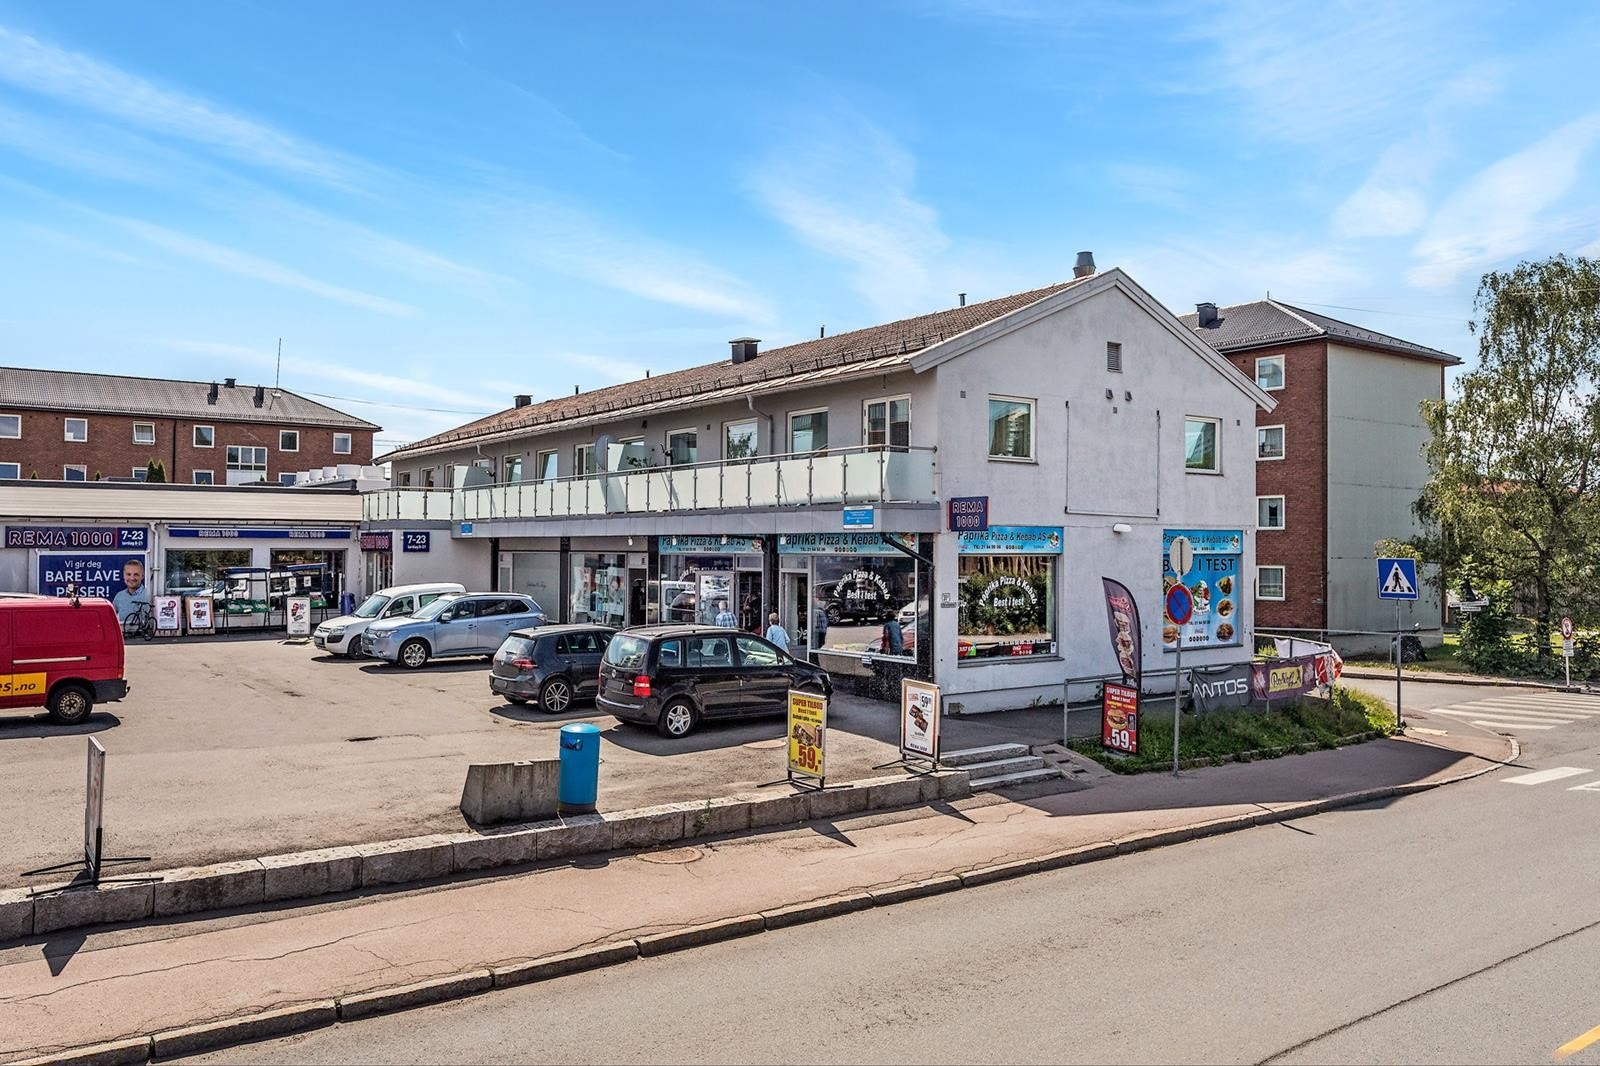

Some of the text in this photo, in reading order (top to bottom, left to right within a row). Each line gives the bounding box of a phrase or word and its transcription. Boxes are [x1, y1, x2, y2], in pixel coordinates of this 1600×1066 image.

[952, 501, 984, 513] REMA
[956, 515, 980, 527] 1000
[9, 530, 113, 546] REMA 1000
[121, 530, 144, 540] 7-23
[407, 535, 427, 544] 7-23
[818, 533, 840, 545] Pizza
[850, 532, 879, 545] Kebab
[958, 529, 989, 543] Paprika
[991, 531, 1008, 541] Pizza
[1010, 531, 1015, 541] &
[1016, 531, 1037, 541] Kebab
[65, 560, 102, 569] Vi gir deg
[1206, 558, 1235, 571] TEST
[45, 570, 120, 582] BARE LAVE
[874, 574, 890, 600] Kebab
[979, 580, 1000, 607] Paprika
[1000, 575, 1015, 586] Pizza
[1021, 580, 1038, 605] Kebab
[847, 588, 860, 599] Best
[865, 590, 877, 600] test
[993, 597, 1007, 607] Best
[1012, 596, 1024, 606] test
